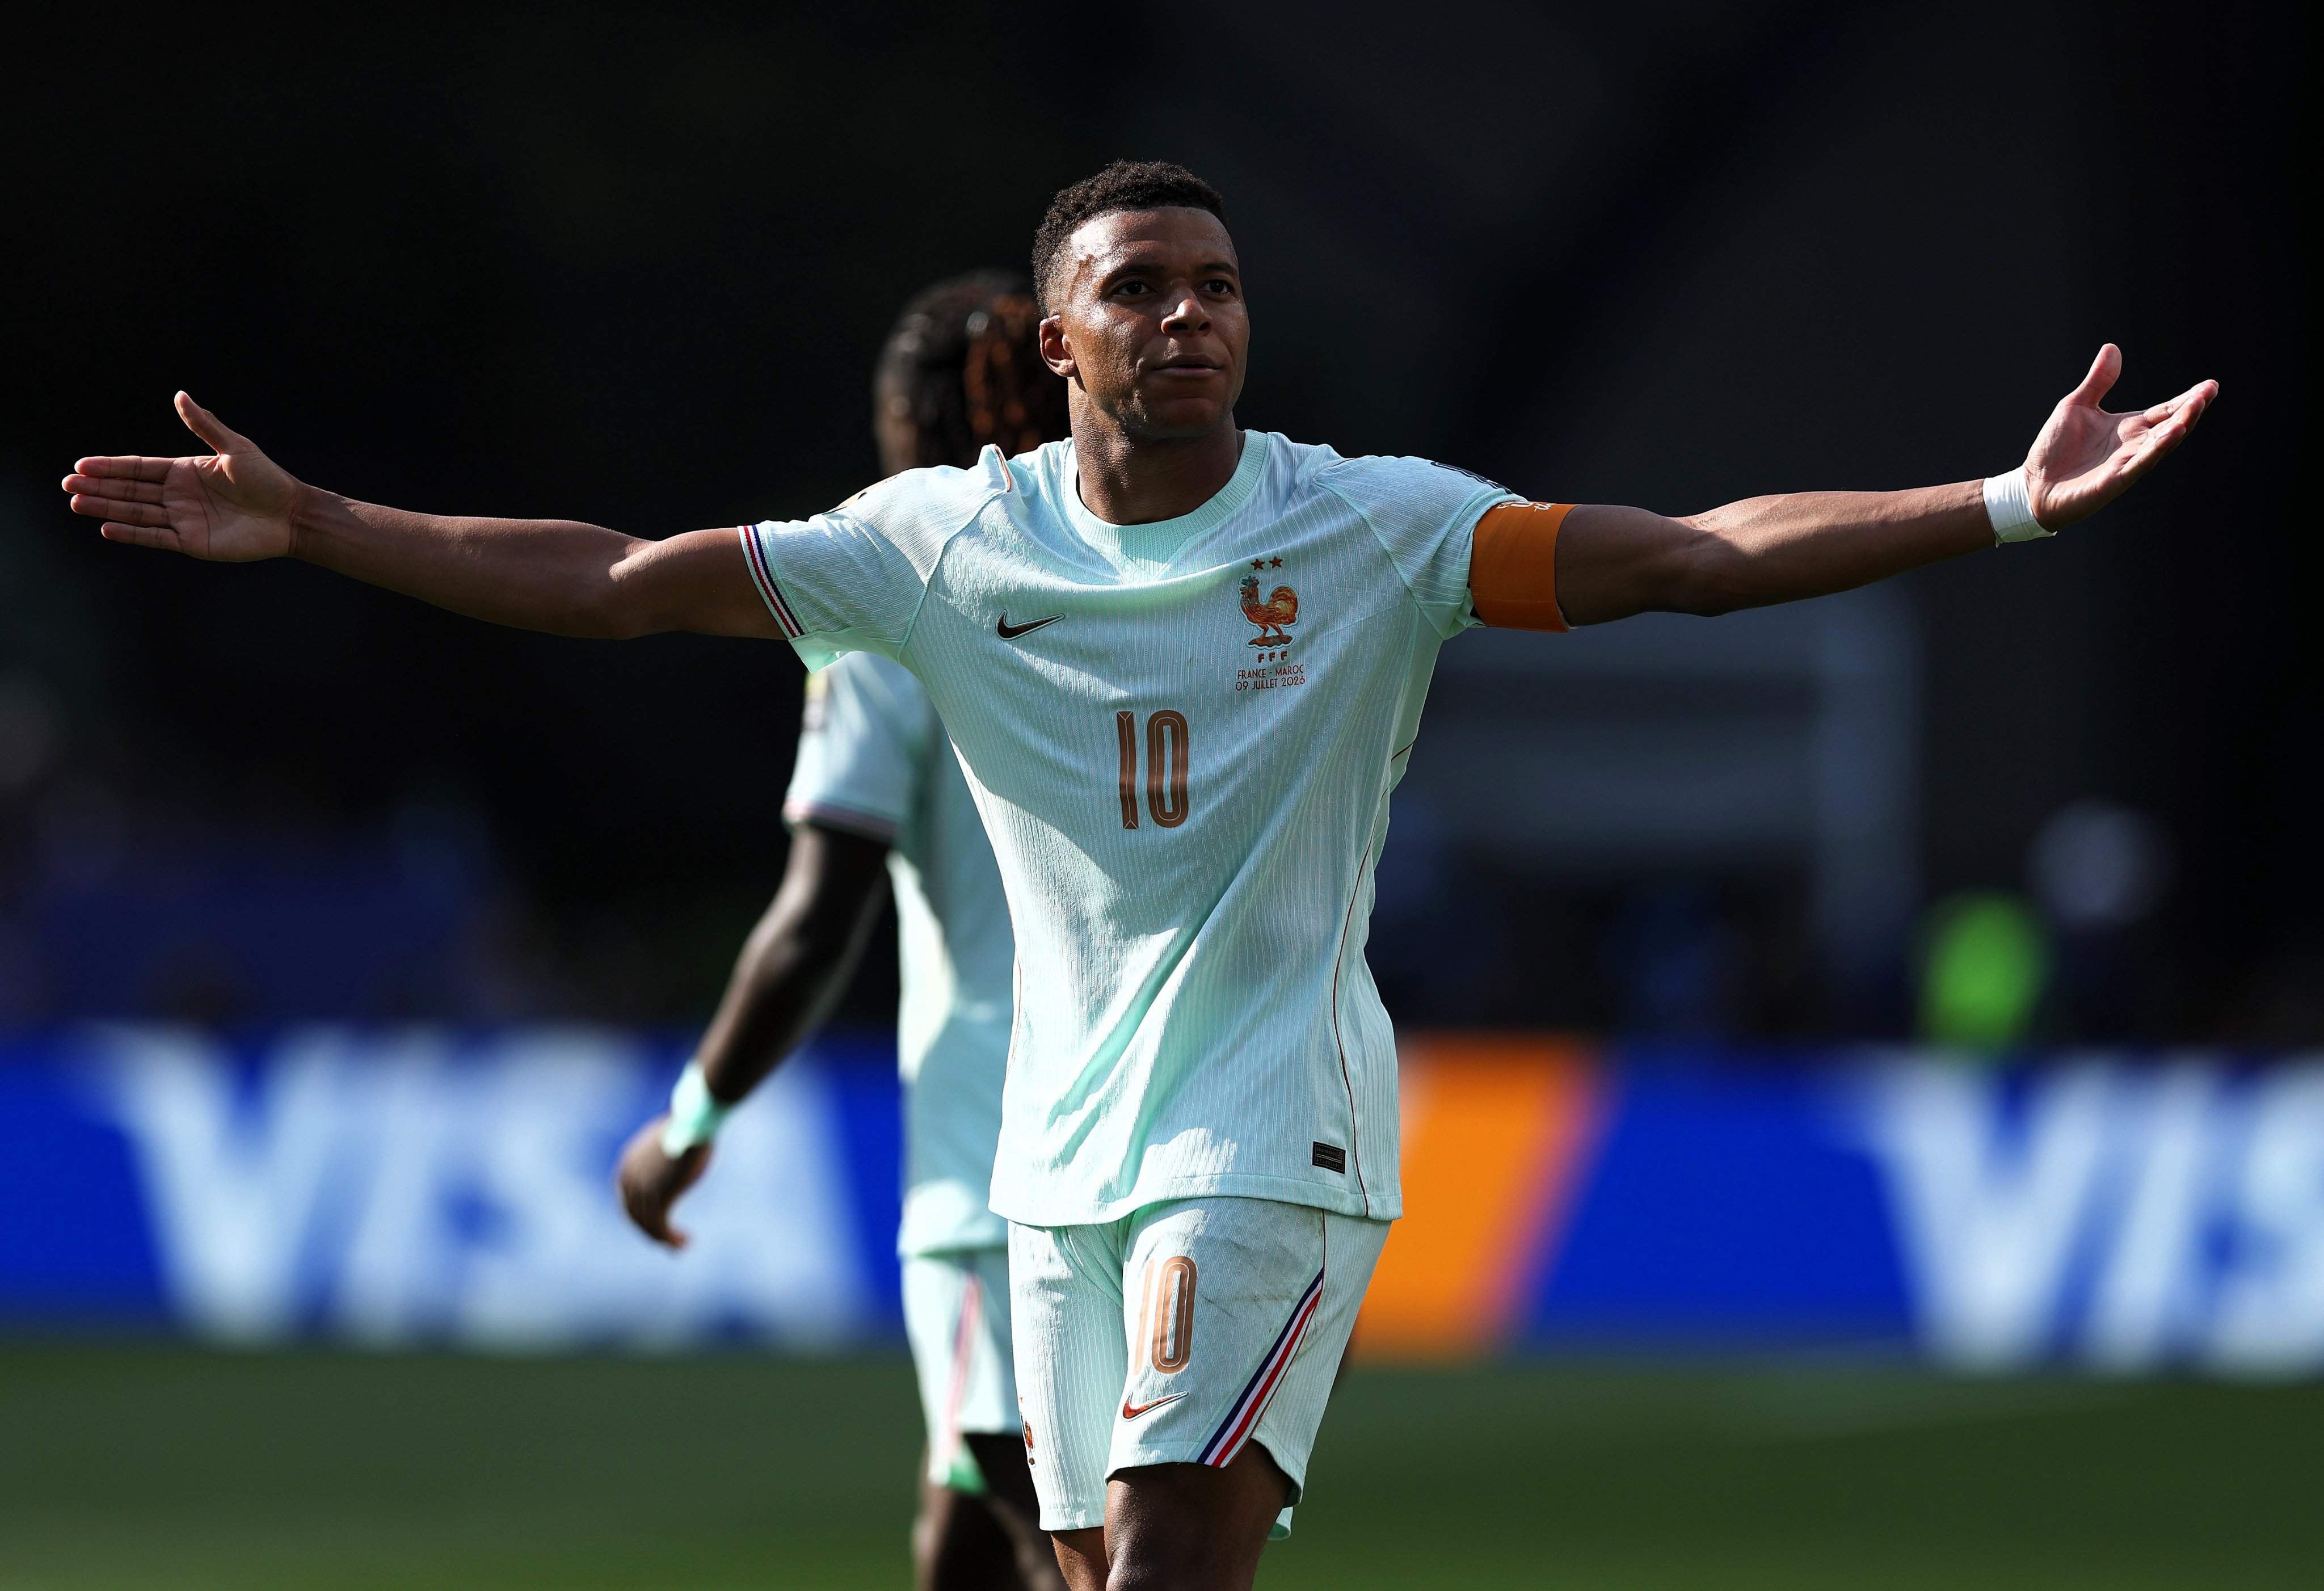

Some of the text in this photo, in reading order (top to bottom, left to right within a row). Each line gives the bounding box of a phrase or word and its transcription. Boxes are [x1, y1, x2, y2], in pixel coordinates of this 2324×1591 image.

[1235, 676, 1305, 691] 09 JUILLET 2026
[1237, 669, 1266, 679] FRANCE
[1275, 664, 1304, 676] MAROC
[1117, 710, 1189, 830] 10
[105, 1036, 868, 1345] VISA
[1134, 1256, 1197, 1375] 10
